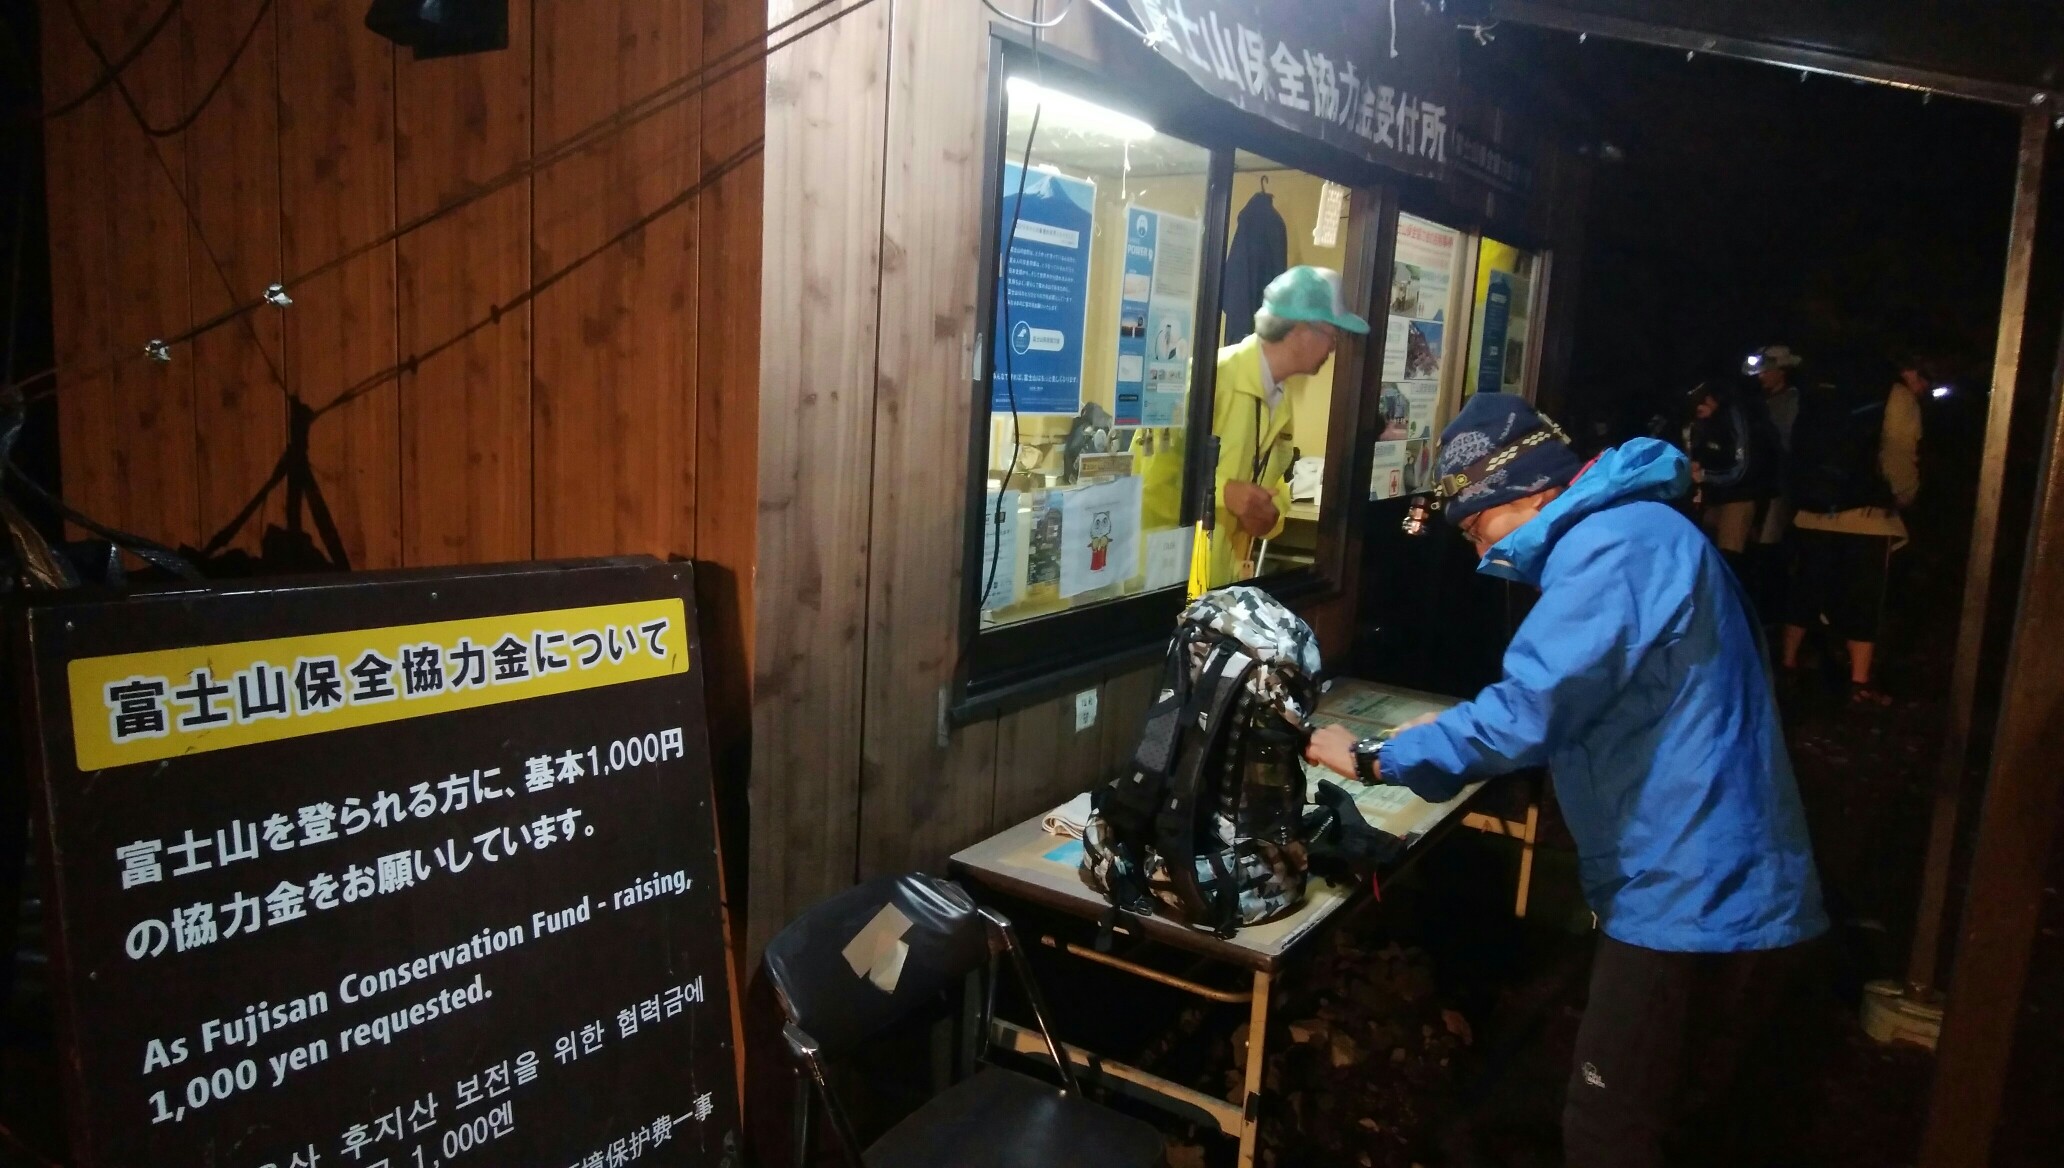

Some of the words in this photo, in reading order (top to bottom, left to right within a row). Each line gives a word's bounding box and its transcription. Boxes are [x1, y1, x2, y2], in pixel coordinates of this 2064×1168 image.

[108, 620, 669, 738] 富士山保全協力金について
[117, 727, 683, 889] 富士山を登られる方に、基本1,000円
[126, 808, 594, 959] の協力金をお願いしています。
[144, 1038, 188, 1074] As
[202, 992, 328, 1053] Fujisan
[340, 927, 523, 1003] Conservation
[533, 896, 590, 938] Fund
[614, 870, 692, 910] raising,
[149, 1060, 256, 1124] 1,000
[269, 1040, 328, 1087] yen
[341, 976, 492, 1052] requested.
[342, 1093, 438, 1159] 후지산
[457, 1051, 539, 1109] 보전을
[555, 1020, 604, 1064] 위한
[617, 976, 703, 1038] 협력금에
[412, 1100, 514, 1168] 1,000엔
[569, 1092, 713, 1168] 境保护费一事
